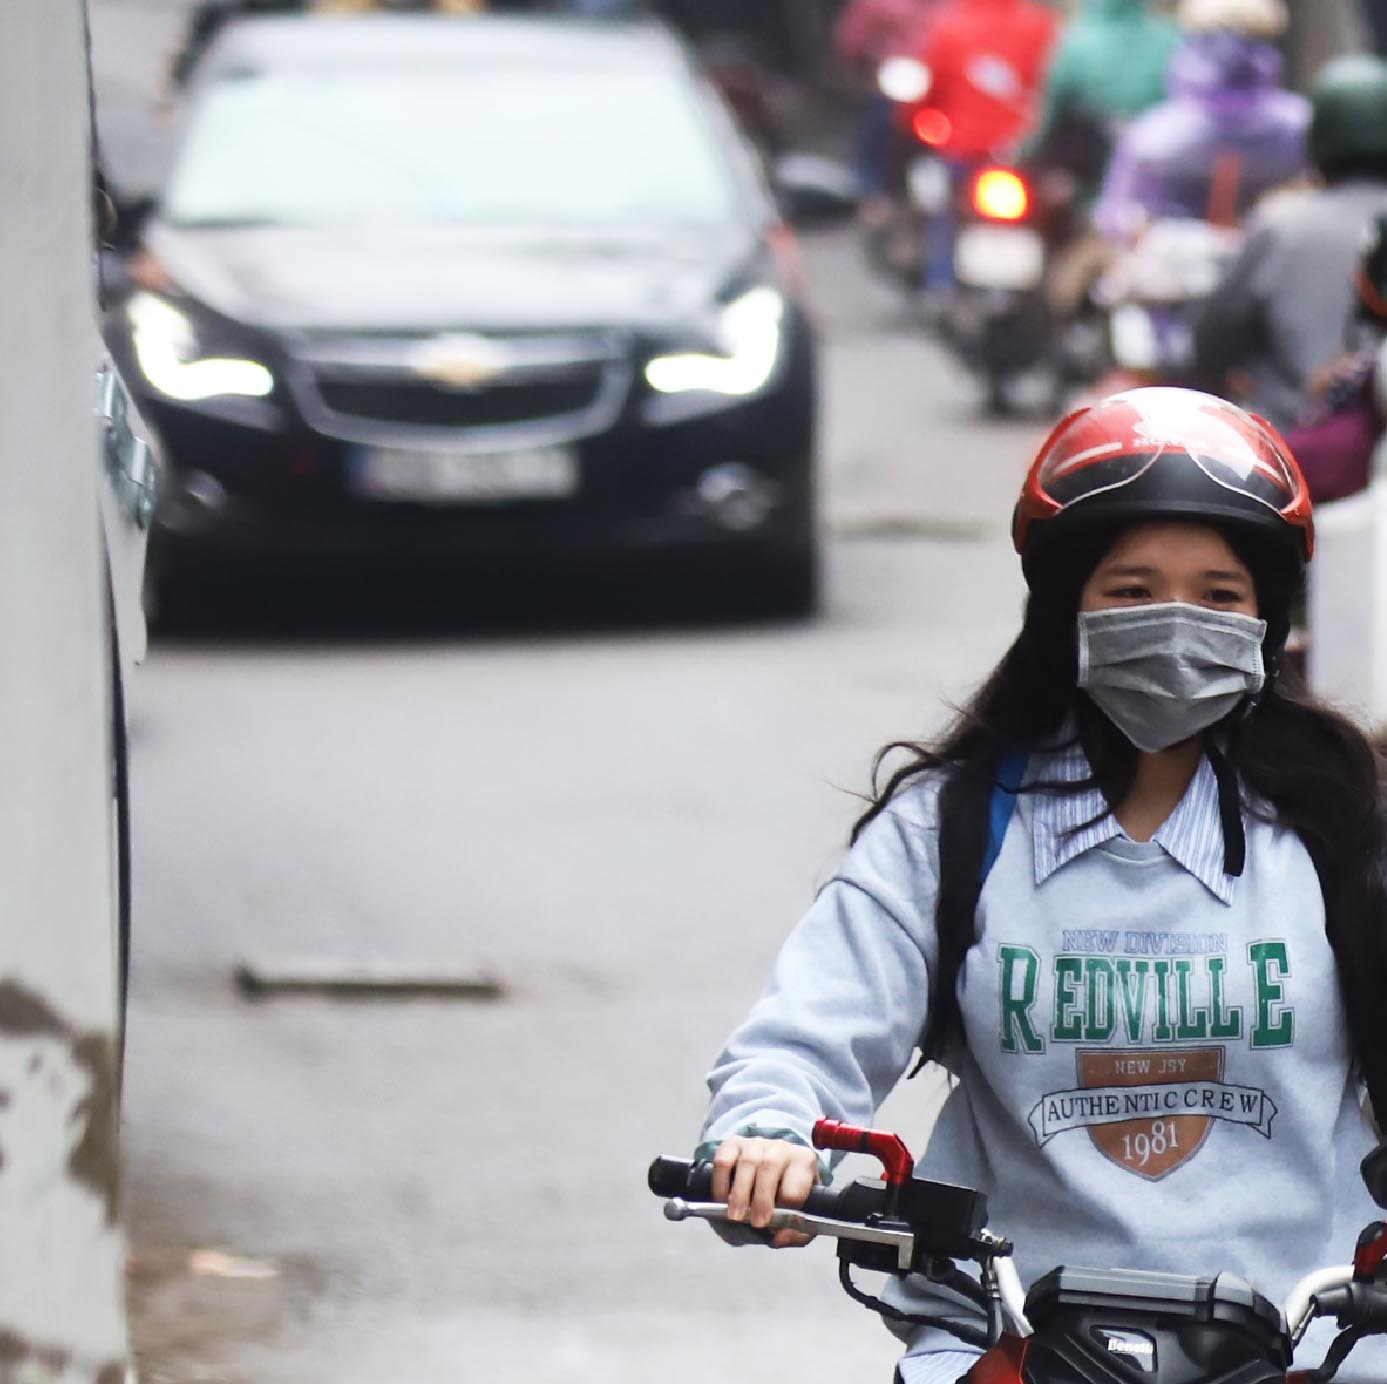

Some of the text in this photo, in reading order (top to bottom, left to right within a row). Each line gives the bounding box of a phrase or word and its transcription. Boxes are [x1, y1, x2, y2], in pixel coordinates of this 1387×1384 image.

[1062, 930, 1228, 955] NEW DIVISION
[997, 938, 1295, 1055] REDVILLE
[1114, 1059, 1187, 1075] NEW JSY
[1123, 1120, 1179, 1166] 1981
